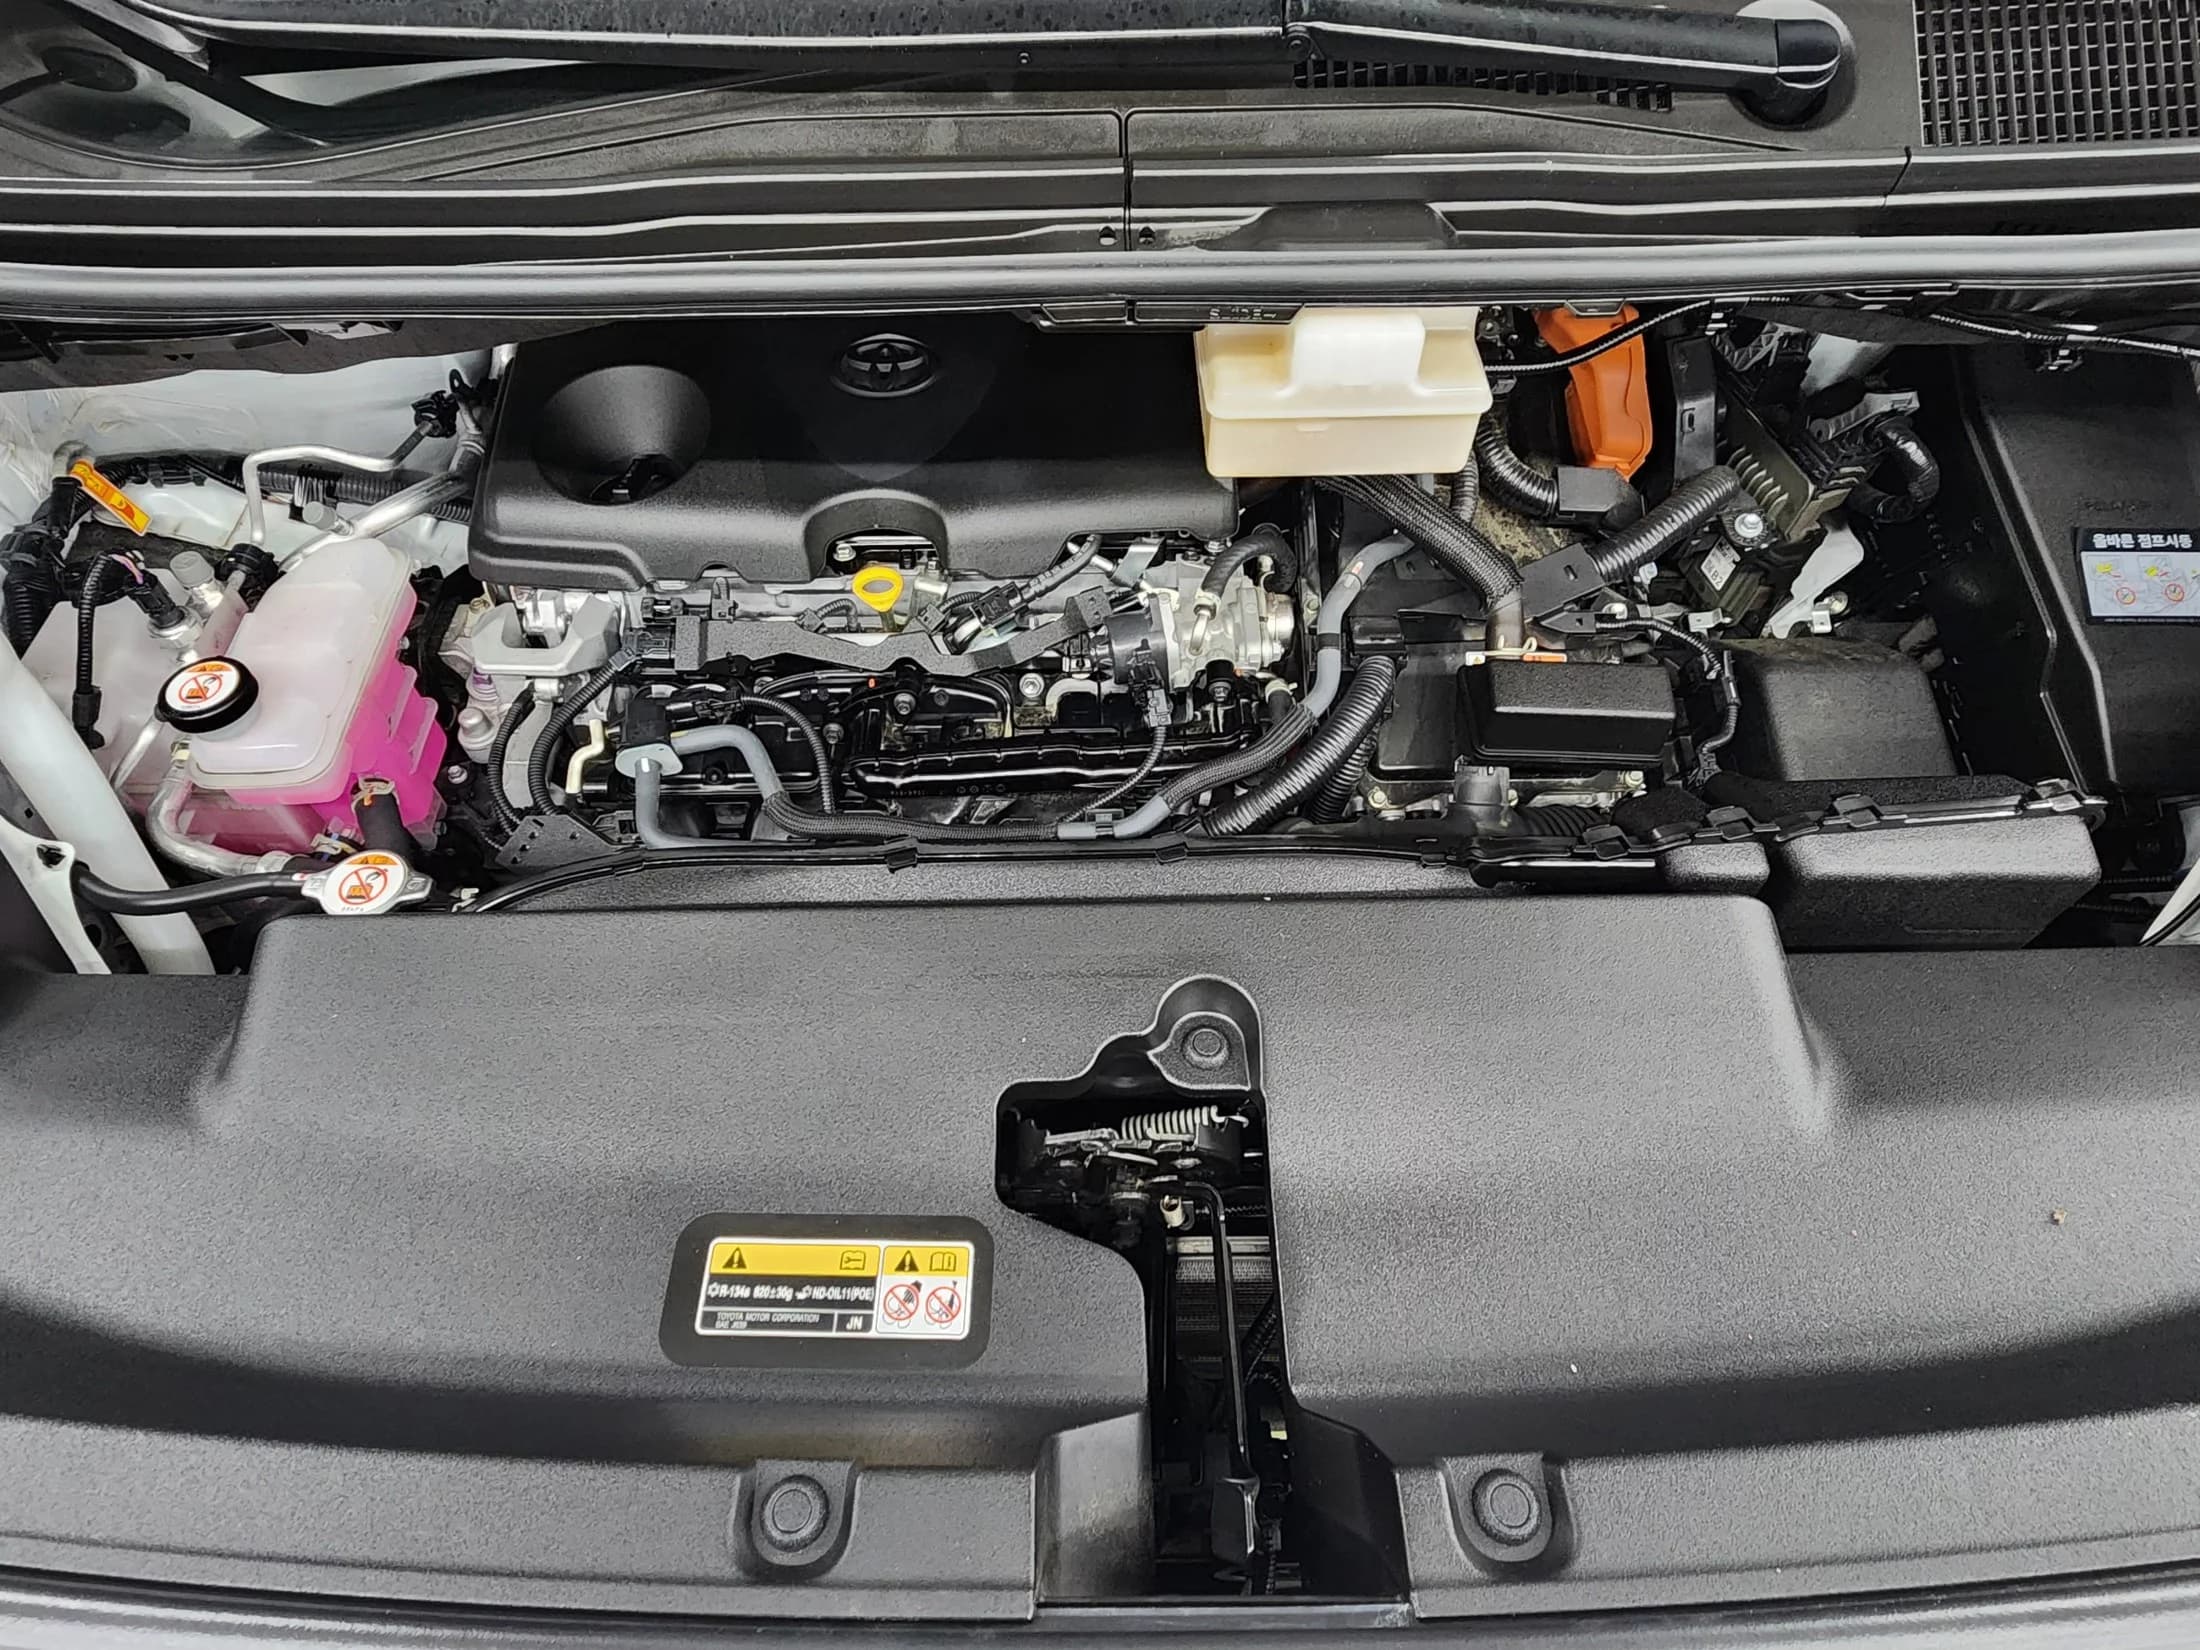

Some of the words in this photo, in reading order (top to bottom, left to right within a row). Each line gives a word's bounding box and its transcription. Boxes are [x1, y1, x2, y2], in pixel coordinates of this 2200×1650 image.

[2093, 533, 2135, 549] 올바른
[2137, 533, 2193, 549] 점프시동
[716, 1312, 744, 1321] TOYOTA
[745, 1312, 771, 1322] MOTOR
[771, 1313, 820, 1323] CORPORATION
[846, 1315, 863, 1330] JN
